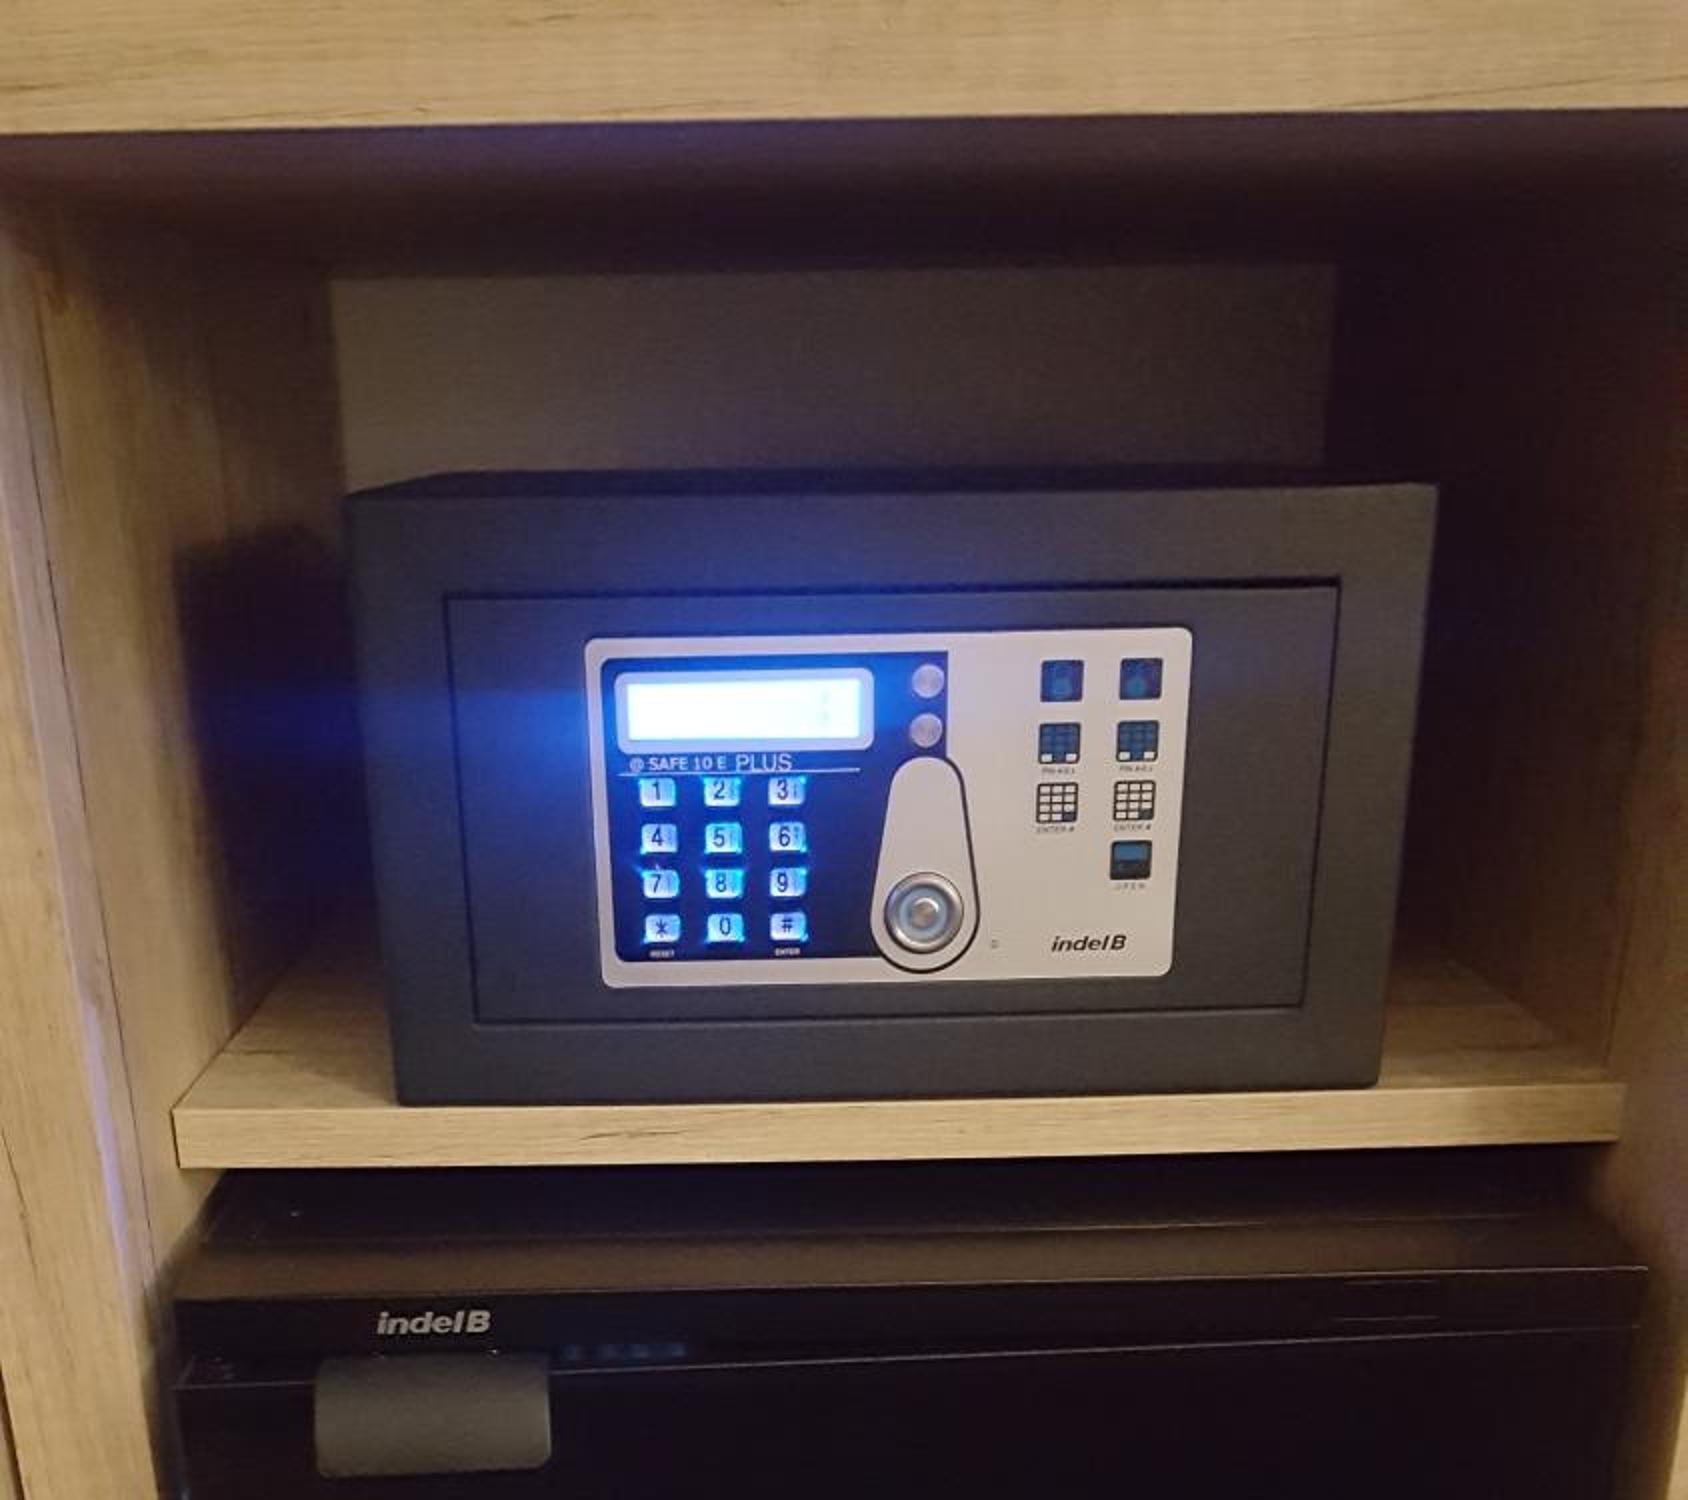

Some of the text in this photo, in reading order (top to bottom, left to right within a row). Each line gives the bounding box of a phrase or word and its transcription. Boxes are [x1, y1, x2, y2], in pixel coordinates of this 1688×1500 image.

[650, 756, 688, 771] SAFE
[695, 756, 712, 770] 10
[717, 756, 727, 770] E
[736, 753, 792, 771] PLUS
[713, 777, 725, 800] 2
[777, 778, 788, 800] 3
[651, 826, 664, 847] 4
[713, 826, 725, 848] 5
[778, 825, 791, 847] 6
[652, 873, 662, 894] 7
[715, 873, 727, 893] 8
[777, 872, 788, 893] 9
[719, 917, 731, 936] 0
